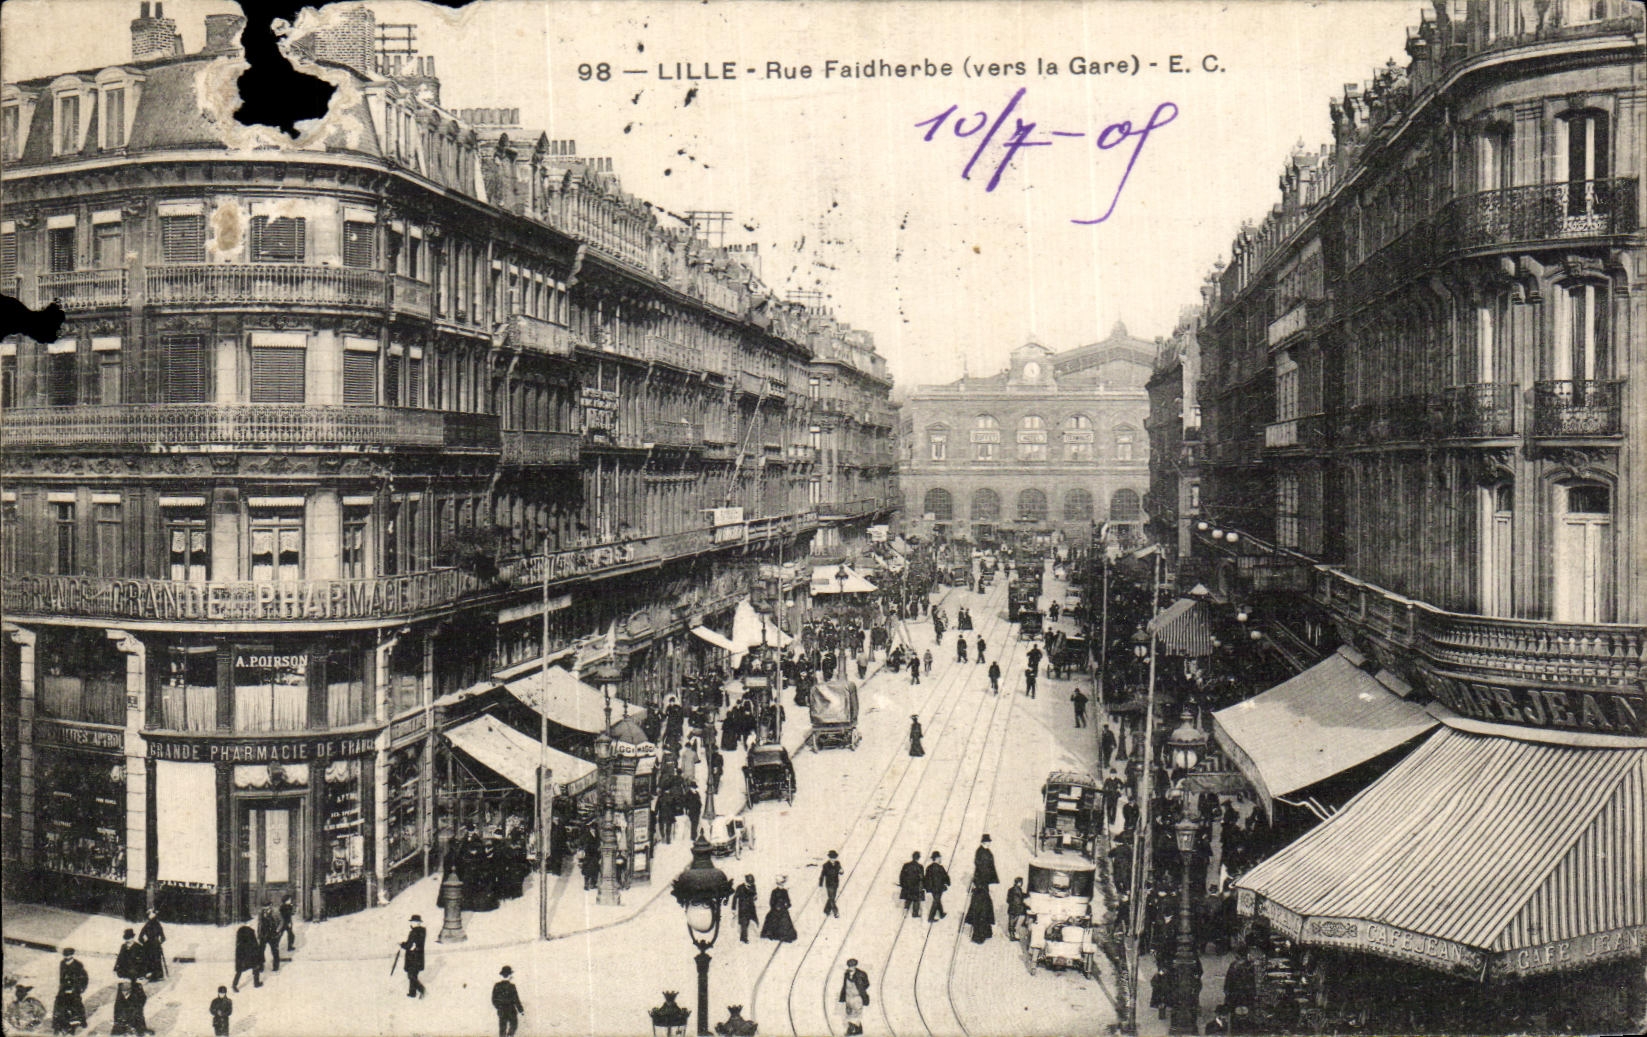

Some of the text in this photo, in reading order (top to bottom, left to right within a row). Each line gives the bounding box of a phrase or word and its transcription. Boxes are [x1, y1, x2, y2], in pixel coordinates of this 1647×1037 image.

[111, 580, 225, 619] GRANDE
[256, 579, 410, 619] PHARMACIE
[150, 738, 376, 761] GRANDE PHARMACIE DE FRANCE
[1367, 924, 1462, 963] CAFE JEAN
[1518, 928, 1640, 969] CAFE JEAN
